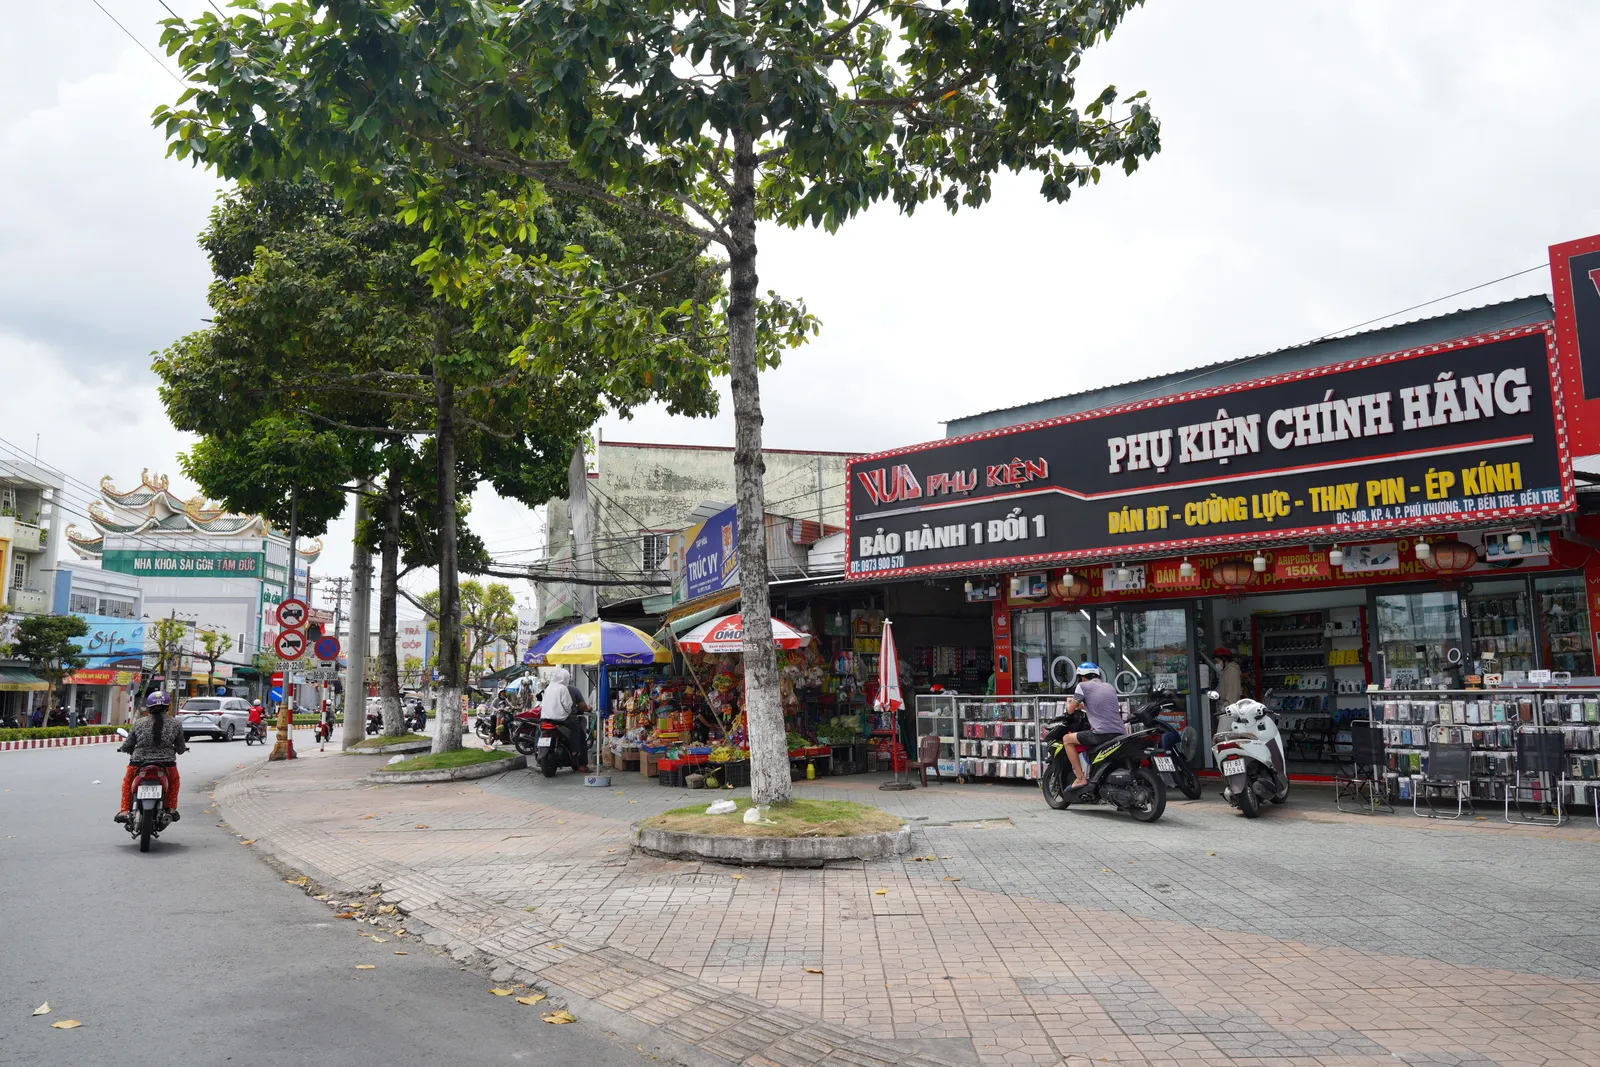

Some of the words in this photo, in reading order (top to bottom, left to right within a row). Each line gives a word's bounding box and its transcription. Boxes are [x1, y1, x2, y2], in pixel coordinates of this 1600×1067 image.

[1107, 428, 1173, 474] PHỤ
[1177, 408, 1262, 465] KIỆN
[1266, 388, 1395, 450] CHÍNH
[1399, 367, 1533, 431] HÃNG
[927, 467, 978, 497] PHỤ
[986, 456, 1049, 489] KIỆN
[1108, 505, 1144, 534] DÁN
[1146, 505, 1169, 530] ĐT
[1184, 492, 1249, 527] CƯỜNG
[1252, 489, 1290, 522] LỰC
[1308, 482, 1359, 513] THAY
[1366, 477, 1405, 507] PIN
[1425, 467, 1455, 500] ÉP
[1461, 460, 1523, 496] KÍNH
[1404, 501, 1422, 517] PHÚ
[1477, 493, 1497, 511] BẾN
[1520, 490, 1540, 507] BẾN
[1541, 489, 1561, 503] TRE
[859, 527, 901, 557] BẢO
[905, 523, 968, 552] HÀNH
[971, 522, 983, 544] 1
[987, 507, 1028, 542] ĐỔI
[1032, 514, 1046, 537] 1
[134, 557, 152, 570] NHA
[154, 558, 177, 570] KHOA
[180, 556, 194, 571] SÀI
[196, 556, 214, 571] GÒN
[217, 557, 236, 571] TÂM
[238, 556, 256, 571] ĐỨC
[688, 554, 707, 581] TRÚC
[707, 552, 718, 575] VY
[861, 559, 877, 572] 0973
[878, 558, 891, 570] 900
[891, 555, 904, 568] 570
[1156, 565, 1176, 584] DÁN
[1285, 563, 1319, 577] 150K
[404, 624, 421, 636] TRẢ
[401, 639, 422, 649] GÓP
